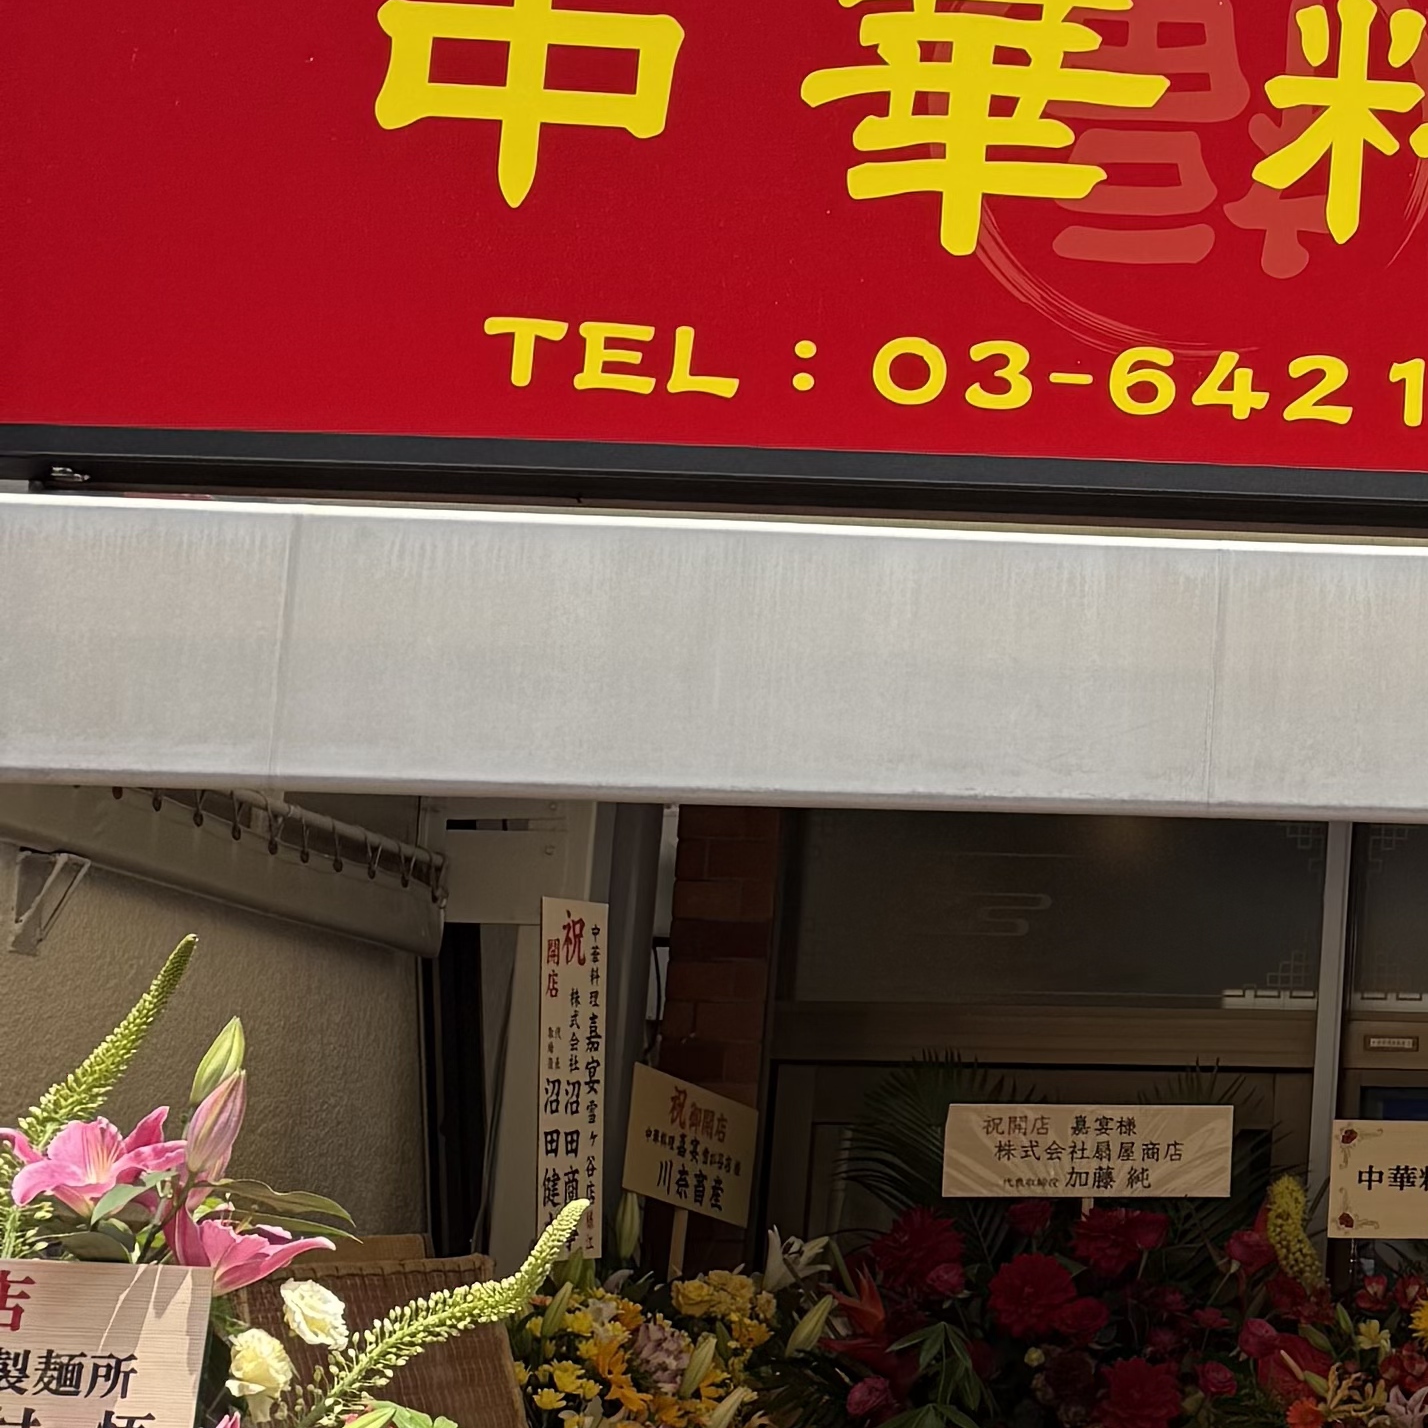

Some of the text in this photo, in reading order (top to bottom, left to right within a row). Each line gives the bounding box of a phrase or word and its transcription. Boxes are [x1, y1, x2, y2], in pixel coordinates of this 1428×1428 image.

[543, 1077, 562, 1227] 沼田健
[565, 987, 582, 1252] 株式会社沼田商
[983, 1115, 1051, 1137] 祝開店
